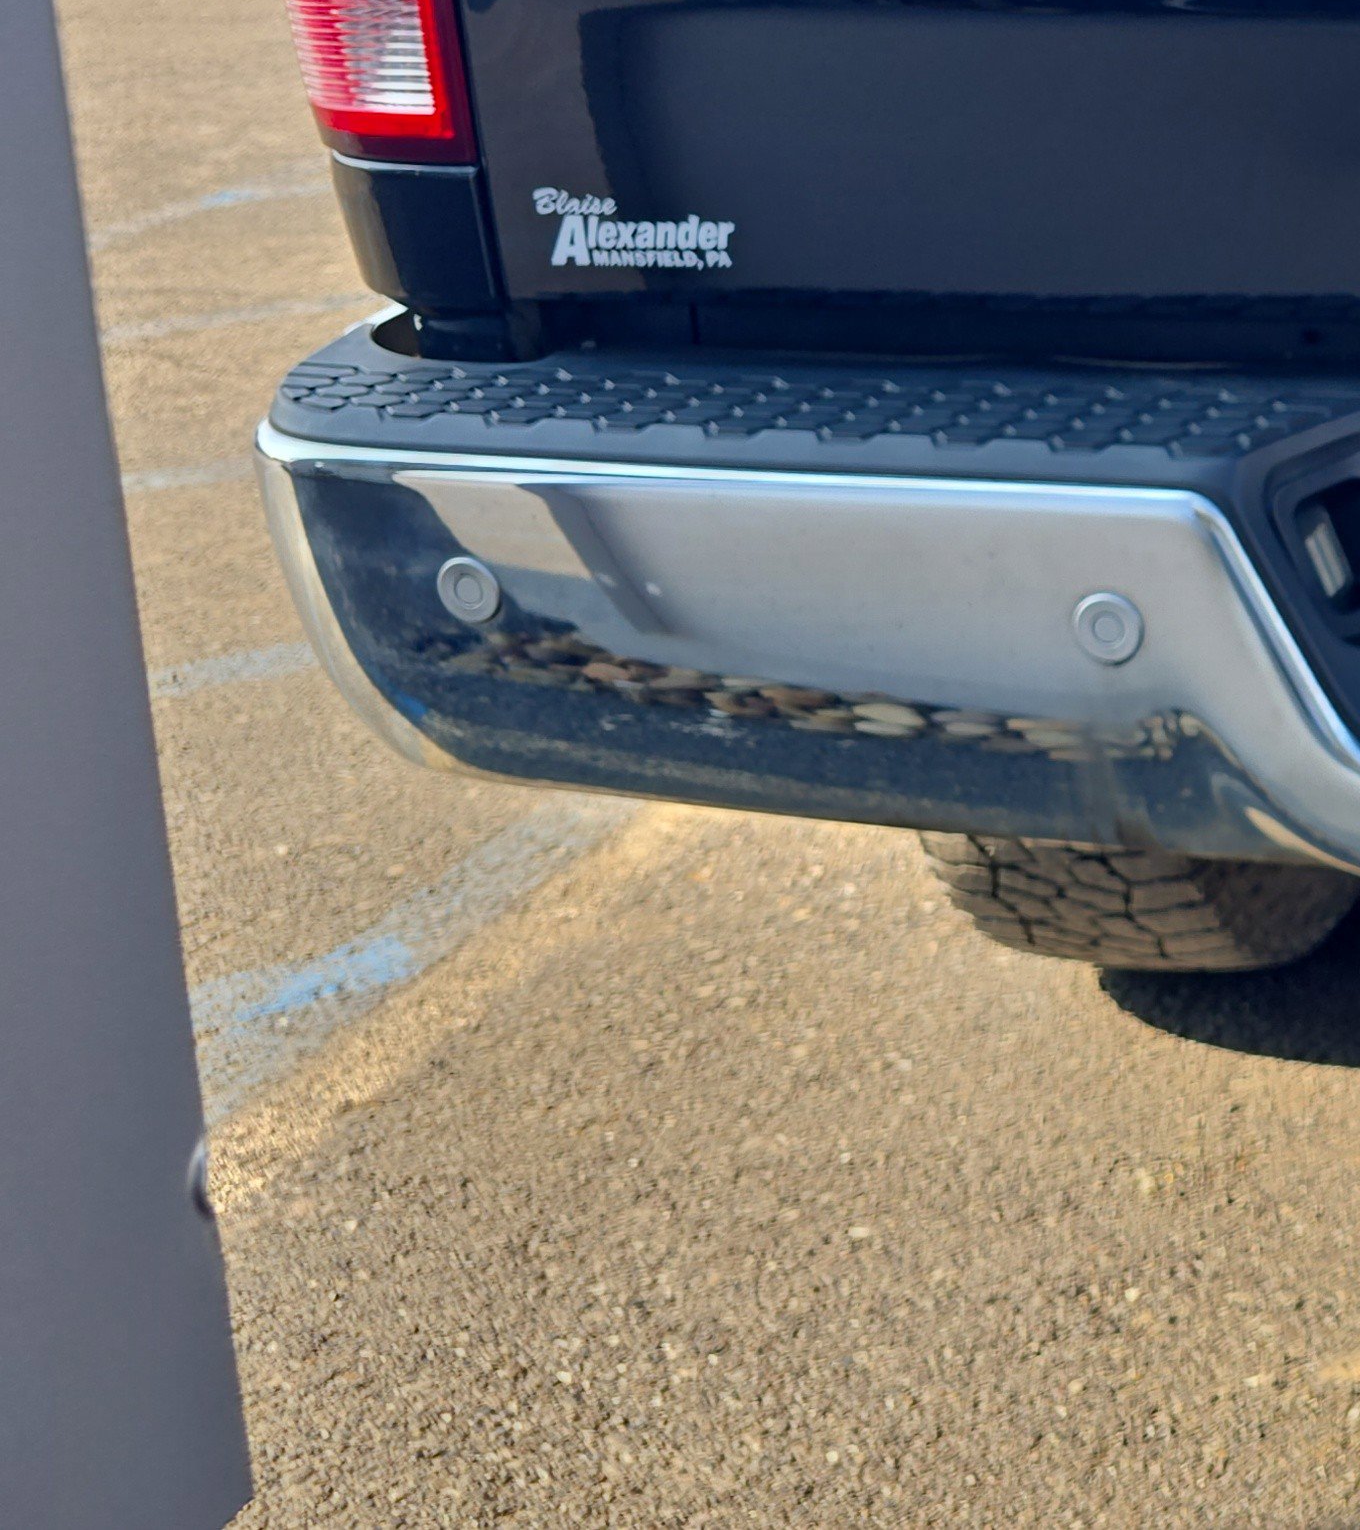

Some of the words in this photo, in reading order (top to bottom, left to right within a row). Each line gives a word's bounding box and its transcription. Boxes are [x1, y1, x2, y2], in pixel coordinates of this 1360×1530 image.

[532, 187, 618, 216] Blaise
[551, 215, 735, 266] Alexander
[593, 250, 704, 270] MANSFIELD,
[706, 251, 732, 267] PA
